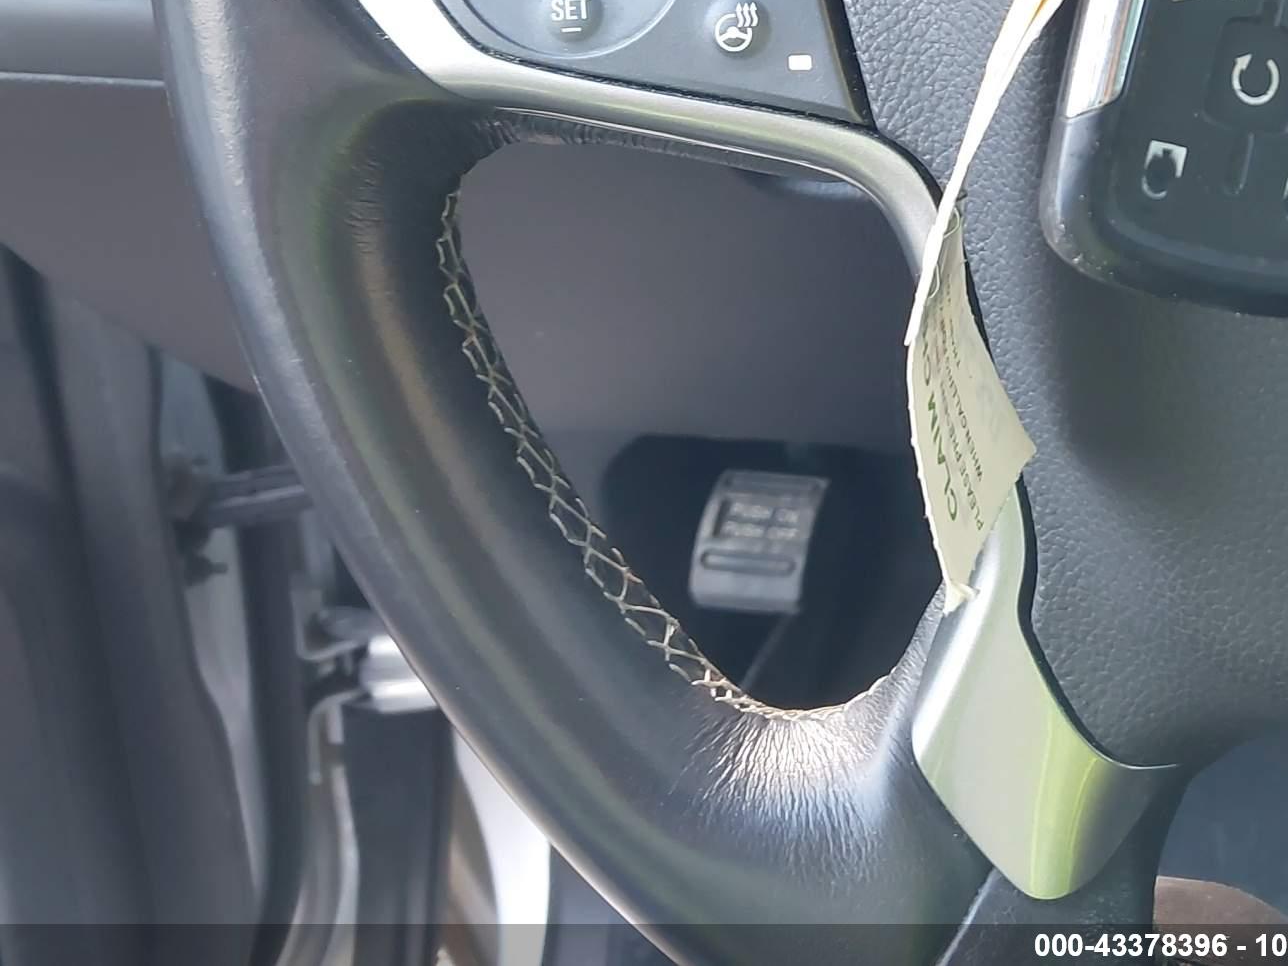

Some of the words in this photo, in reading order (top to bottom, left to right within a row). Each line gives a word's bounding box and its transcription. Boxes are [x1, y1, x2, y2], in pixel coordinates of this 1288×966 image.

[927, 390, 959, 522] CLAIM
[963, 430, 984, 482] WHEN
[957, 461, 985, 531] PLEASE
